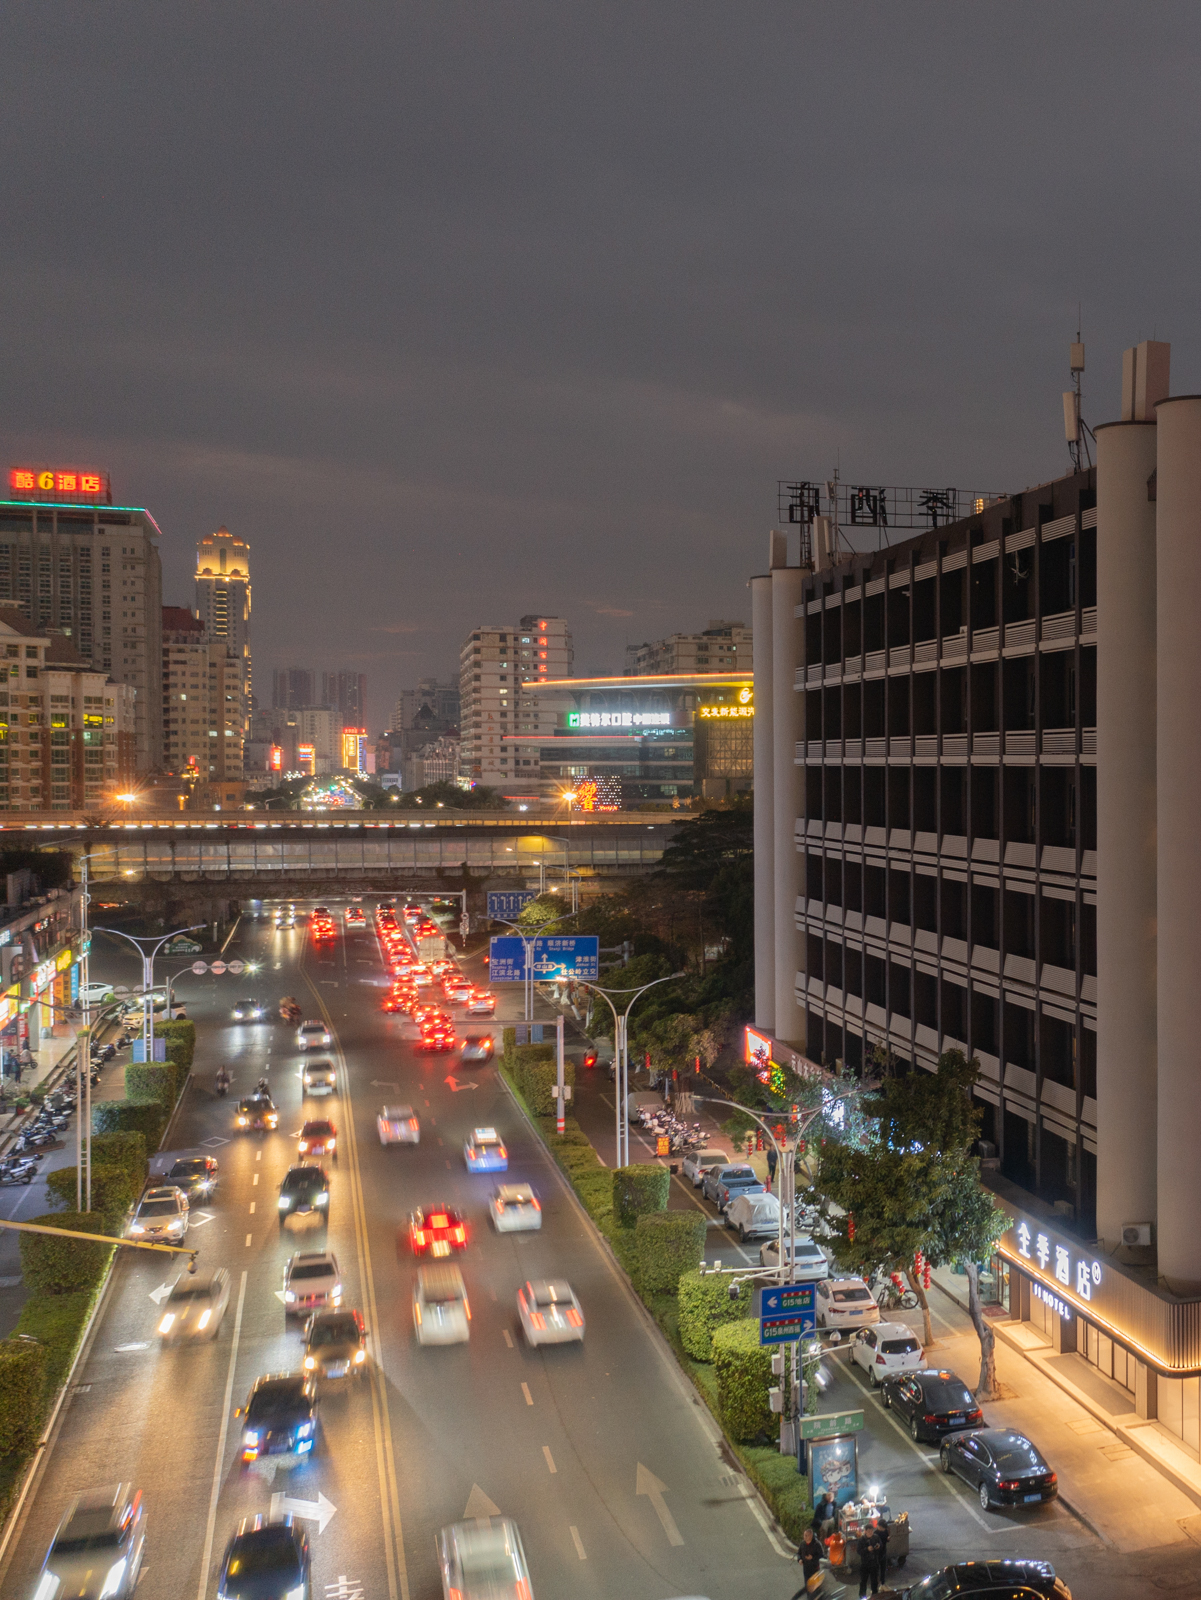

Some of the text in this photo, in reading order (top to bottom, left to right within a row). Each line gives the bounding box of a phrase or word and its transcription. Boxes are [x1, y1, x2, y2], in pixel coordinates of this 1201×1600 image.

[14, 471, 101, 492] 酷6酒店
[1017, 1222, 1091, 1301] 全季酒店
[1042, 1290, 1070, 1320] HOTEL
